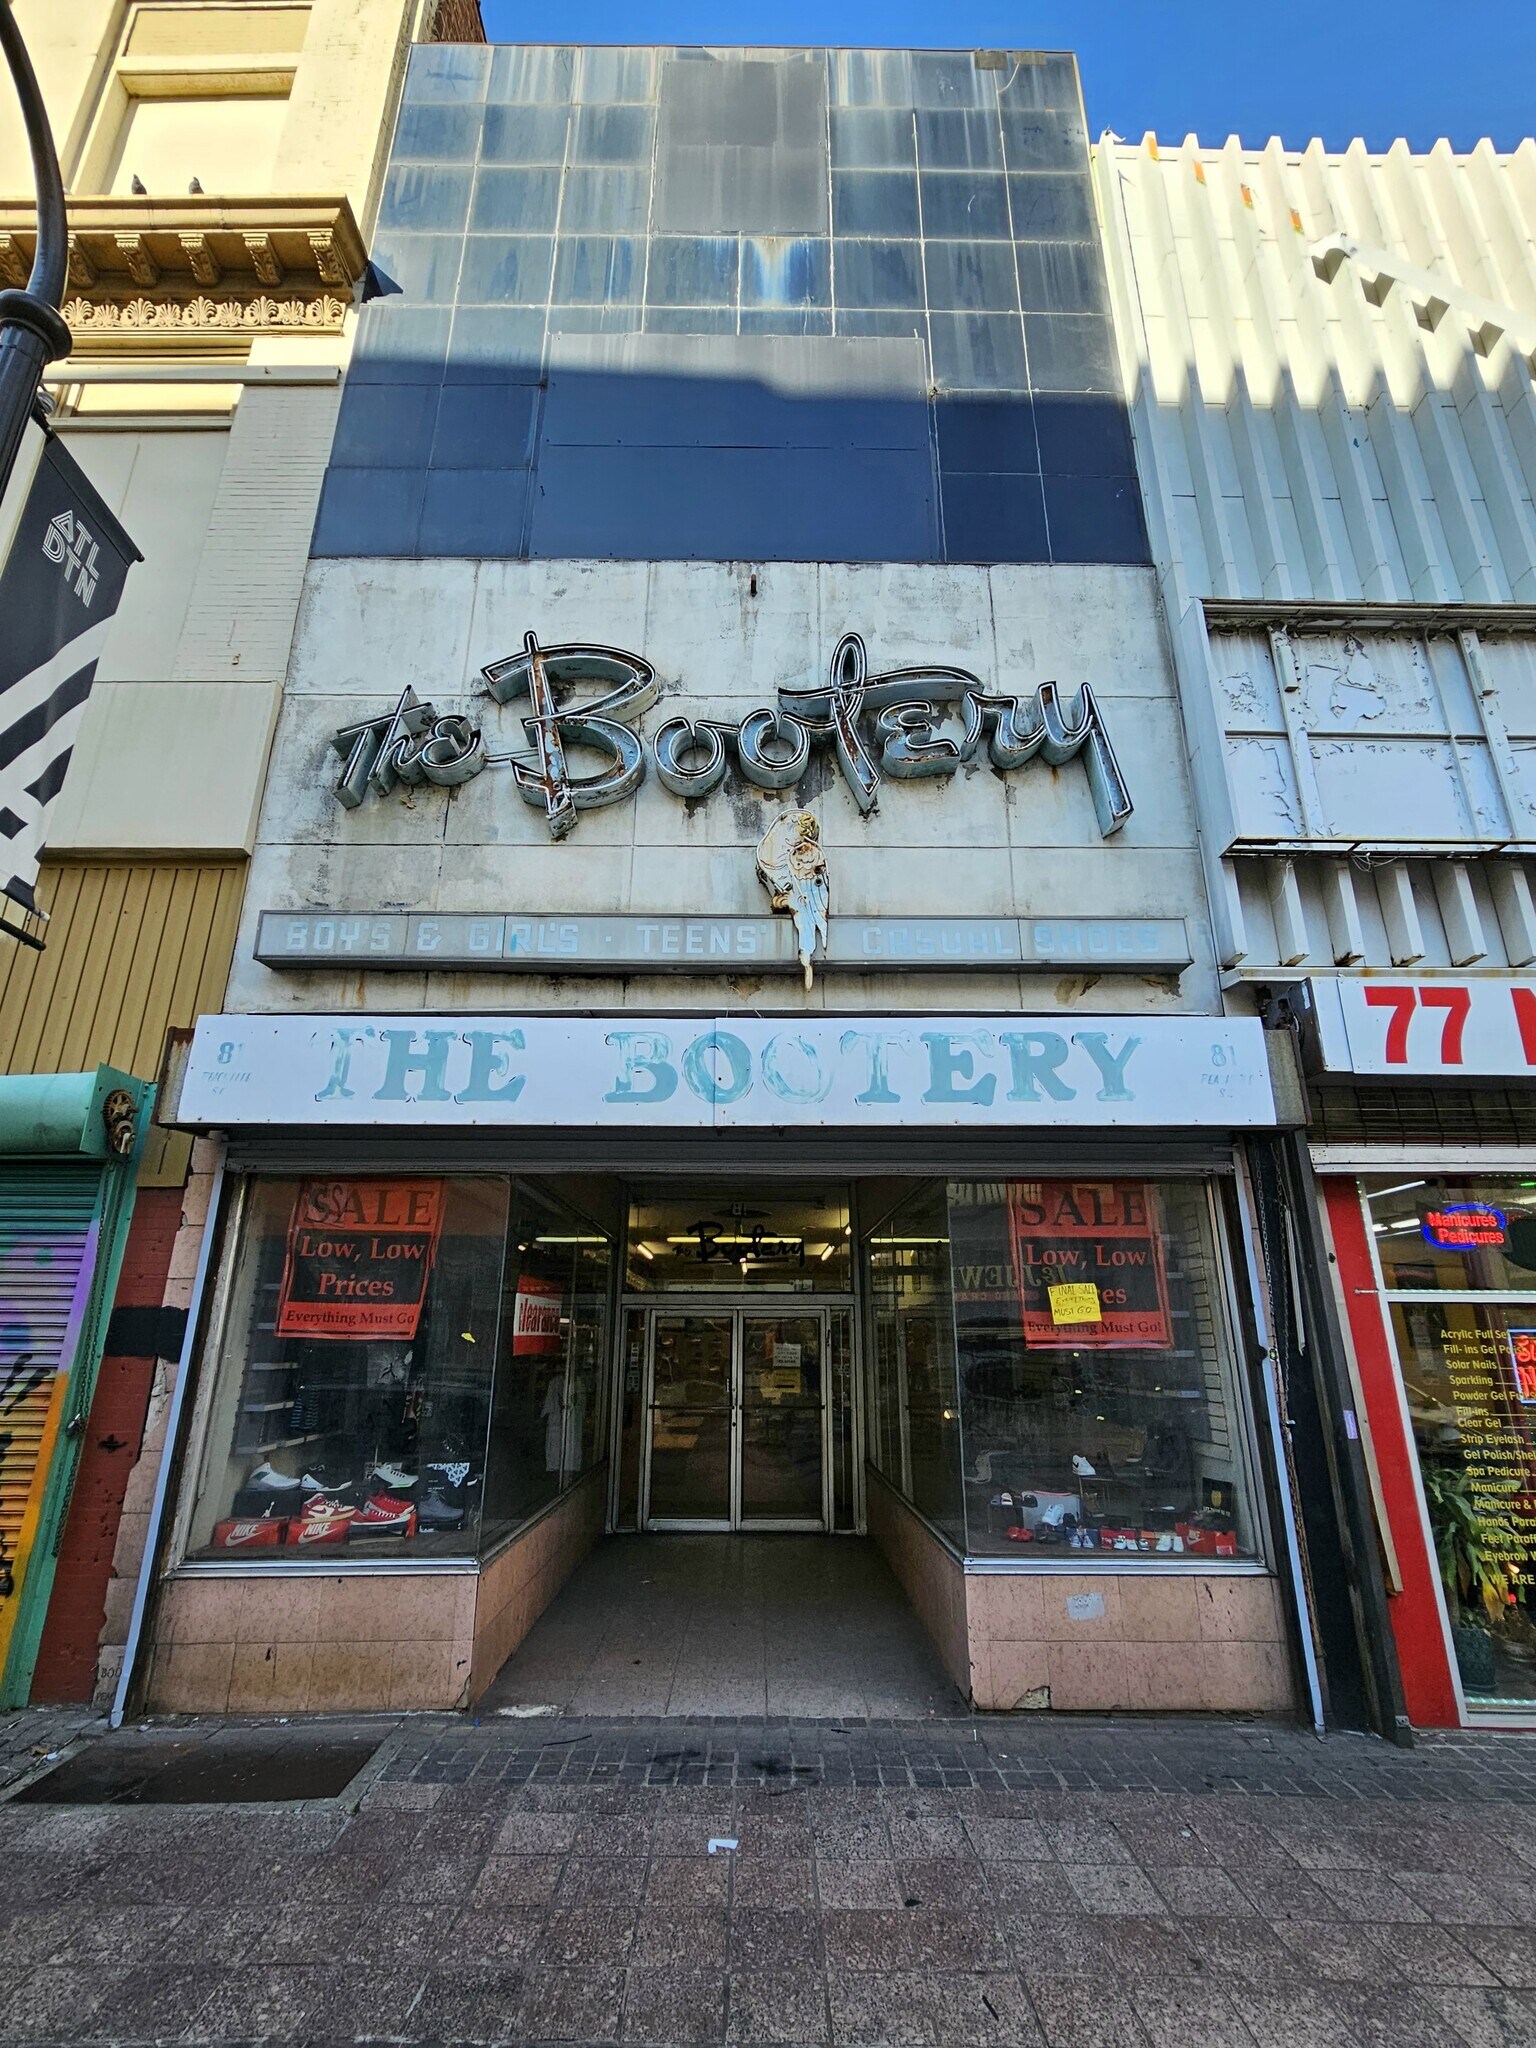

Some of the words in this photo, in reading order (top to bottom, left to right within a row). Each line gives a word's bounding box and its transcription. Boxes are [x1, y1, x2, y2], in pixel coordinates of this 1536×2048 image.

[330, 684, 487, 810] The
[286, 921, 390, 952] BOY'S
[416, 922, 441, 953] &
[469, 922, 578, 954] GIRL'S
[861, 926, 1015, 956] CASUAL
[1032, 925, 1159, 953] SHOES
[1364, 986, 1471, 1065] 77
[315, 1026, 527, 1104] THE
[602, 1027, 1144, 1107] BOOTERY
[1021, 1190, 1148, 1228] SALE
[1427, 1211, 1498, 1228] Manicures
[1438, 1227, 1505, 1245] Pedicures
[300, 1235, 361, 1263] Low,
[370, 1237, 425, 1261] Low
[1026, 1244, 1087, 1270] Low,
[1095, 1245, 1147, 1266] Low
[318, 1272, 395, 1297] Prices
[286, 1310, 356, 1326] Everything
[359, 1312, 393, 1325] Must
[1027, 1321, 1098, 1336] Everything
[1101, 1321, 1134, 1333] Must
[1138, 1321, 1162, 1333] Go!
[1441, 1329, 1474, 1341] Acrylic
[1475, 1329, 1494, 1339] Full
[1464, 1345, 1479, 1354] ins
[1480, 1345, 1497, 1354] Gel
[1446, 1360, 1471, 1370] Solar
[1472, 1360, 1498, 1370] Nails
[1450, 1375, 1494, 1387] Sparkling
[1453, 1391, 1488, 1401] Powder
[1490, 1391, 1508, 1401] Gel
[1456, 1406, 1490, 1416] Fill-ins
[1457, 1418, 1482, 1428] Clear
[1484, 1418, 1502, 1428] Gel
[1460, 1434, 1484, 1445] Strip
[1485, 1434, 1525, 1446] Eyelash
[1463, 1450, 1481, 1460] Gel
[1466, 1466, 1486, 1478] Spa
[1487, 1466, 1531, 1477] Pedicure
[1471, 1482, 1519, 1493] Manicure
[1474, 1499, 1522, 1510] Manicure
[1523, 1499, 1533, 1510] &
[1477, 1516, 1510, 1527] Hands
[1511, 1516, 1536, 1527] Para
[231, 1524, 260, 1537] NIKE
[304, 1522, 331, 1535] NIKE
[1480, 1533, 1504, 1544] Feet
[1484, 1550, 1529, 1563] Eyebrow
[1489, 1574, 1509, 1585] WE
[1512, 1574, 1536, 1585] ARE
